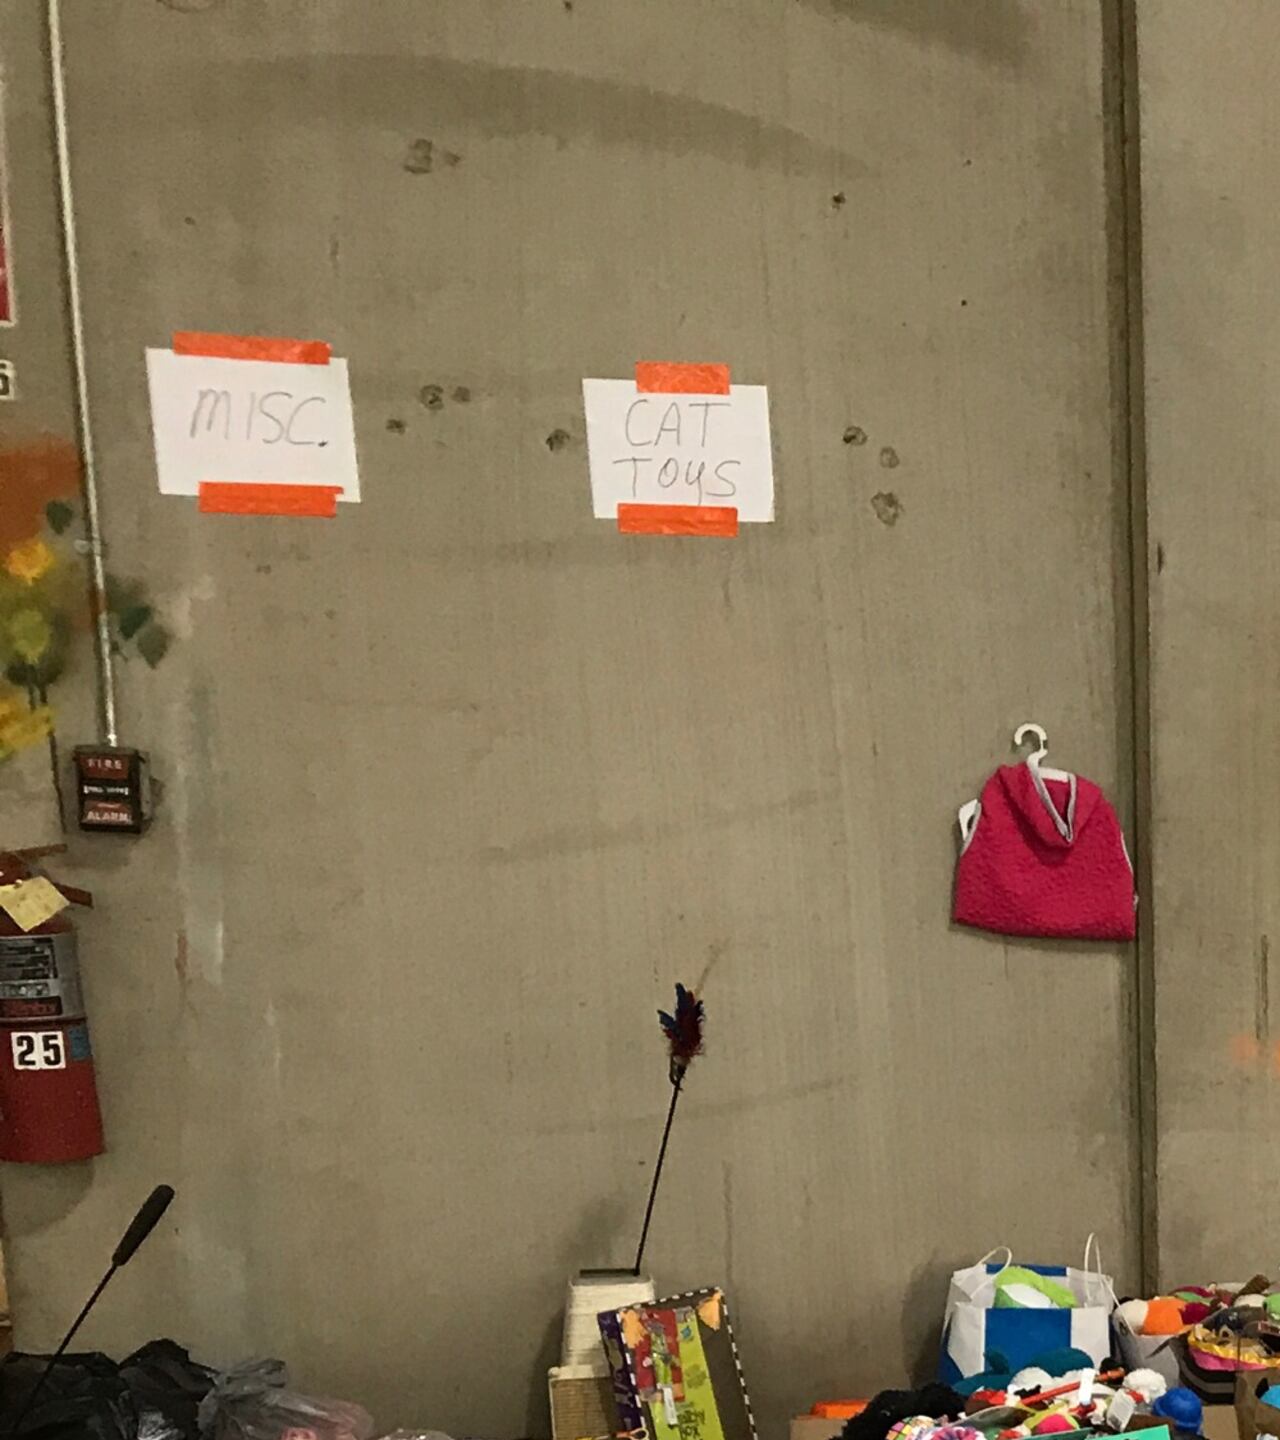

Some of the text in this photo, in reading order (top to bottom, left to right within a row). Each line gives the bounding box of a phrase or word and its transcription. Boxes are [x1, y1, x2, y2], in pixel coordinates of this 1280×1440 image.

[189, 388, 329, 447] MISC.
[624, 398, 732, 448] CAT
[612, 456, 742, 506] TOYS
[86, 811, 129, 822] ALARM
[15, 1034, 62, 1067] 25
